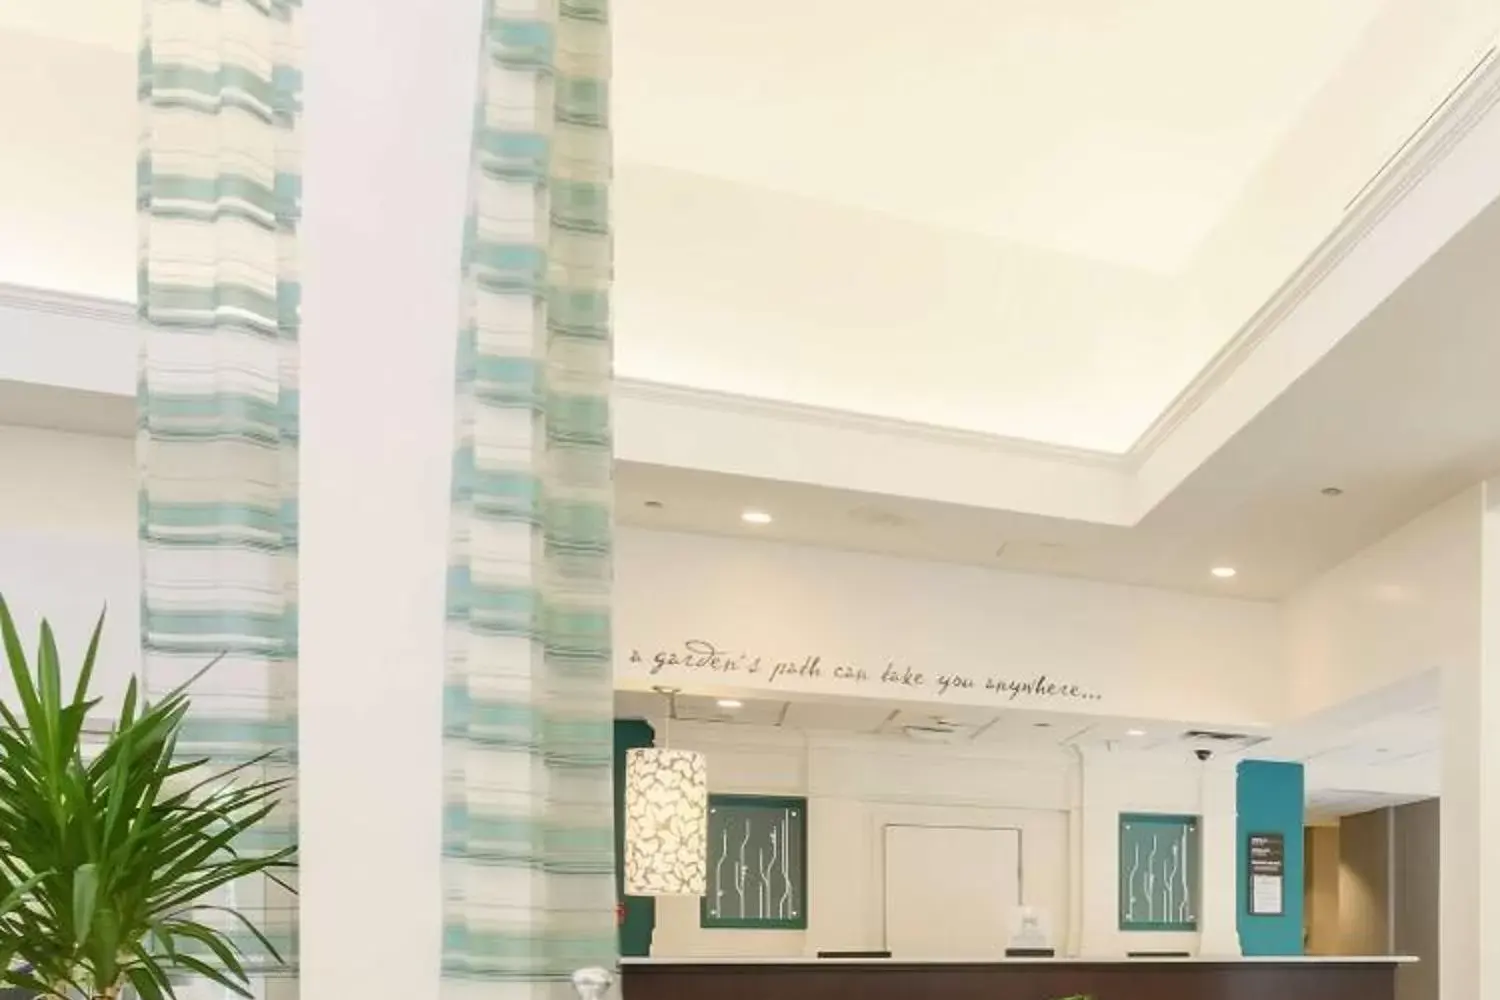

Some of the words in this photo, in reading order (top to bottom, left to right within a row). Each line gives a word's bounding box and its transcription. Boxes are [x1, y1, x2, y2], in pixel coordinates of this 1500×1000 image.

[629, 649, 642, 663] a
[650, 639, 761, 675] garden's
[768, 655, 821, 682] path
[833, 663, 868, 682] can
[881, 662, 924, 686] take
[938, 672, 973, 696] you
